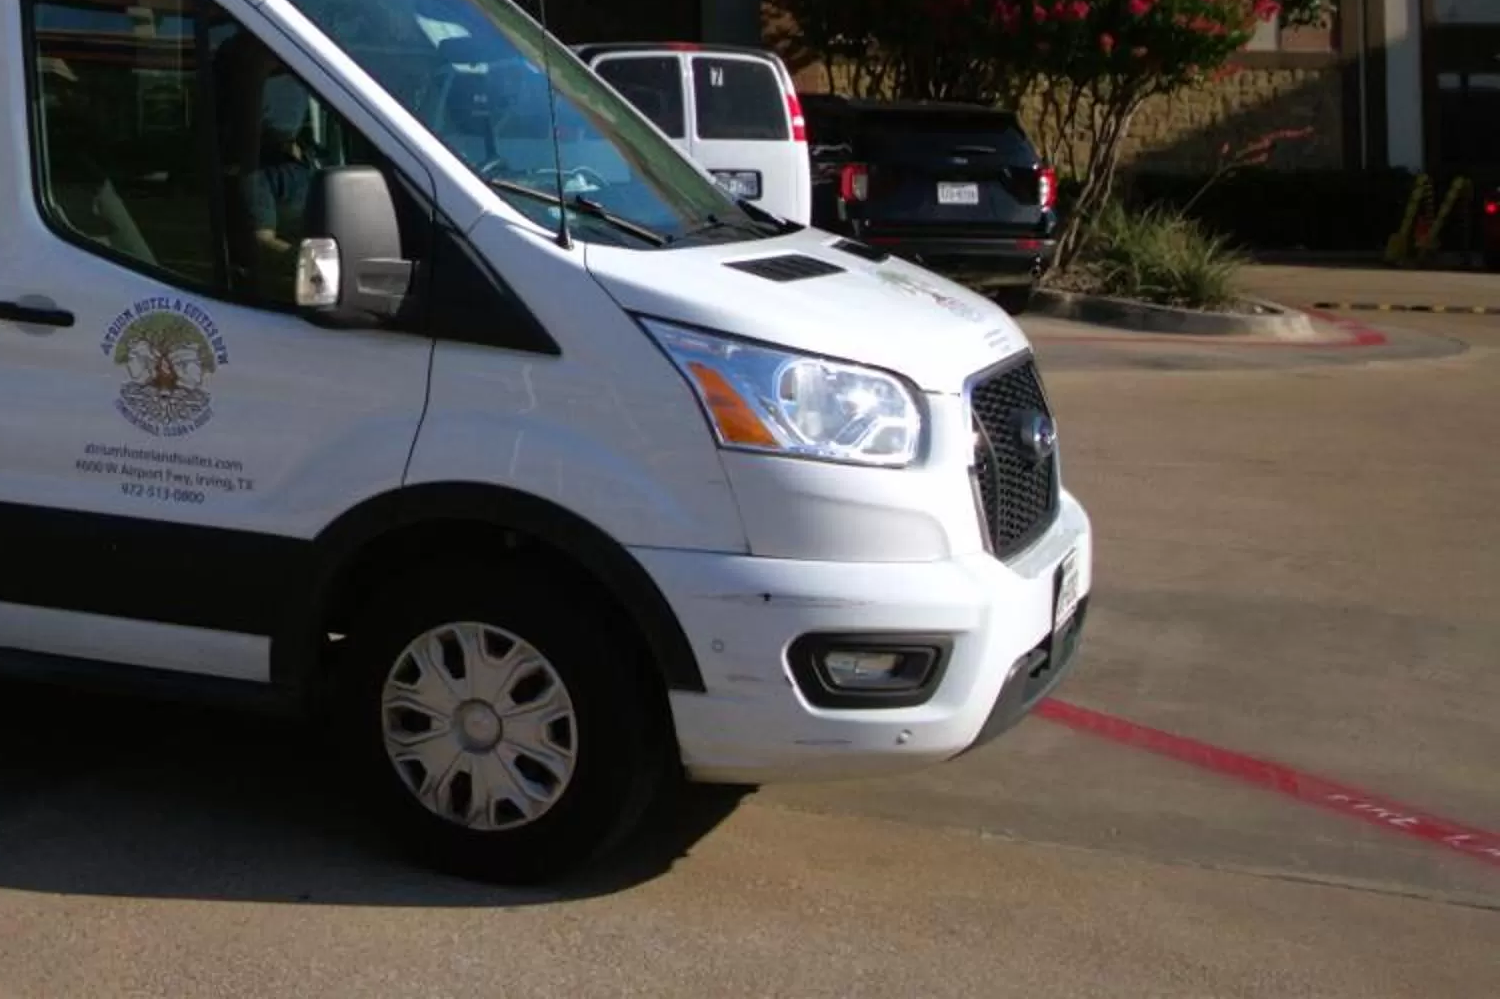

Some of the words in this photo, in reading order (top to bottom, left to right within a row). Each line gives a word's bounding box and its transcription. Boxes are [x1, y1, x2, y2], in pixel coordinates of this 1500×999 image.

[100, 310, 134, 355] ATRIUM
[133, 297, 169, 315] HOTEL
[120, 462, 163, 482] Airport
